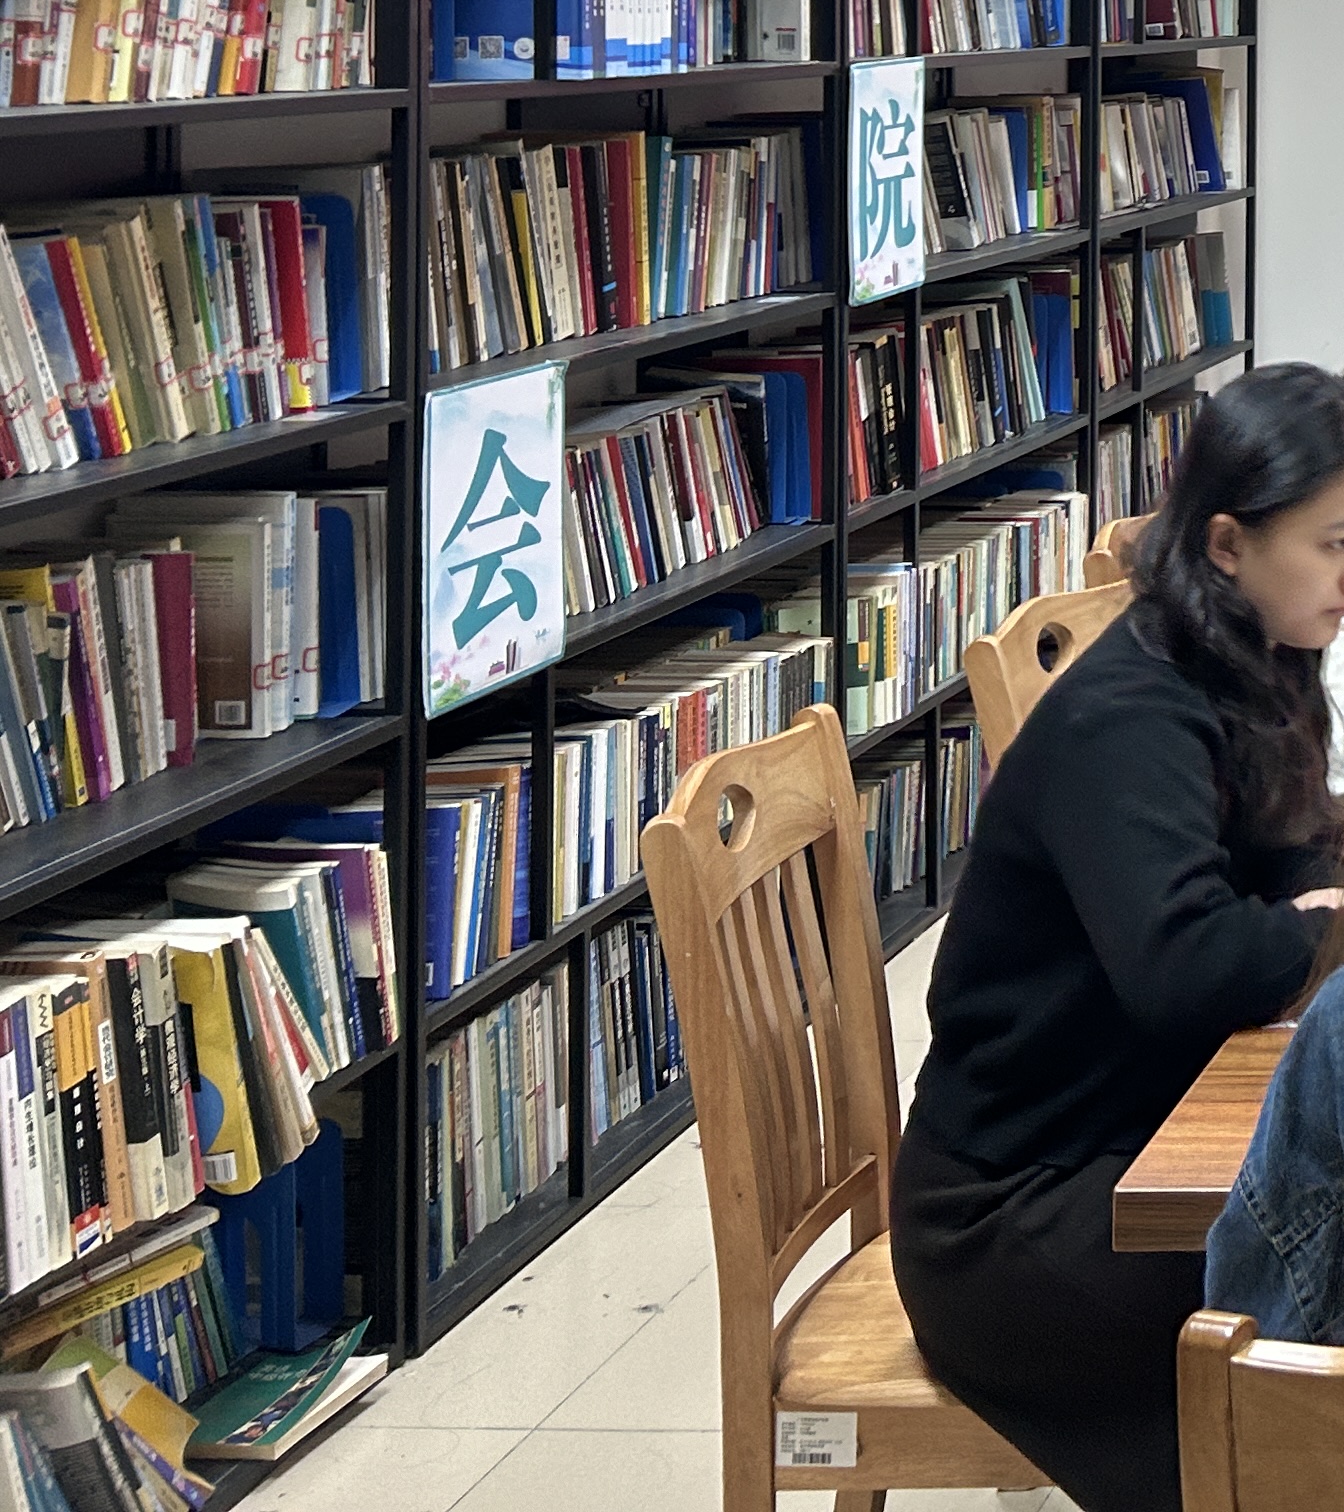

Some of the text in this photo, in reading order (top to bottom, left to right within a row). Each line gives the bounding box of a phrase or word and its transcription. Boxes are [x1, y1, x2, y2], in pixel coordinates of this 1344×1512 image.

[859, 98, 916, 262] 院
[441, 428, 551, 650] 会
[130, 987, 148, 1046] 会计学
